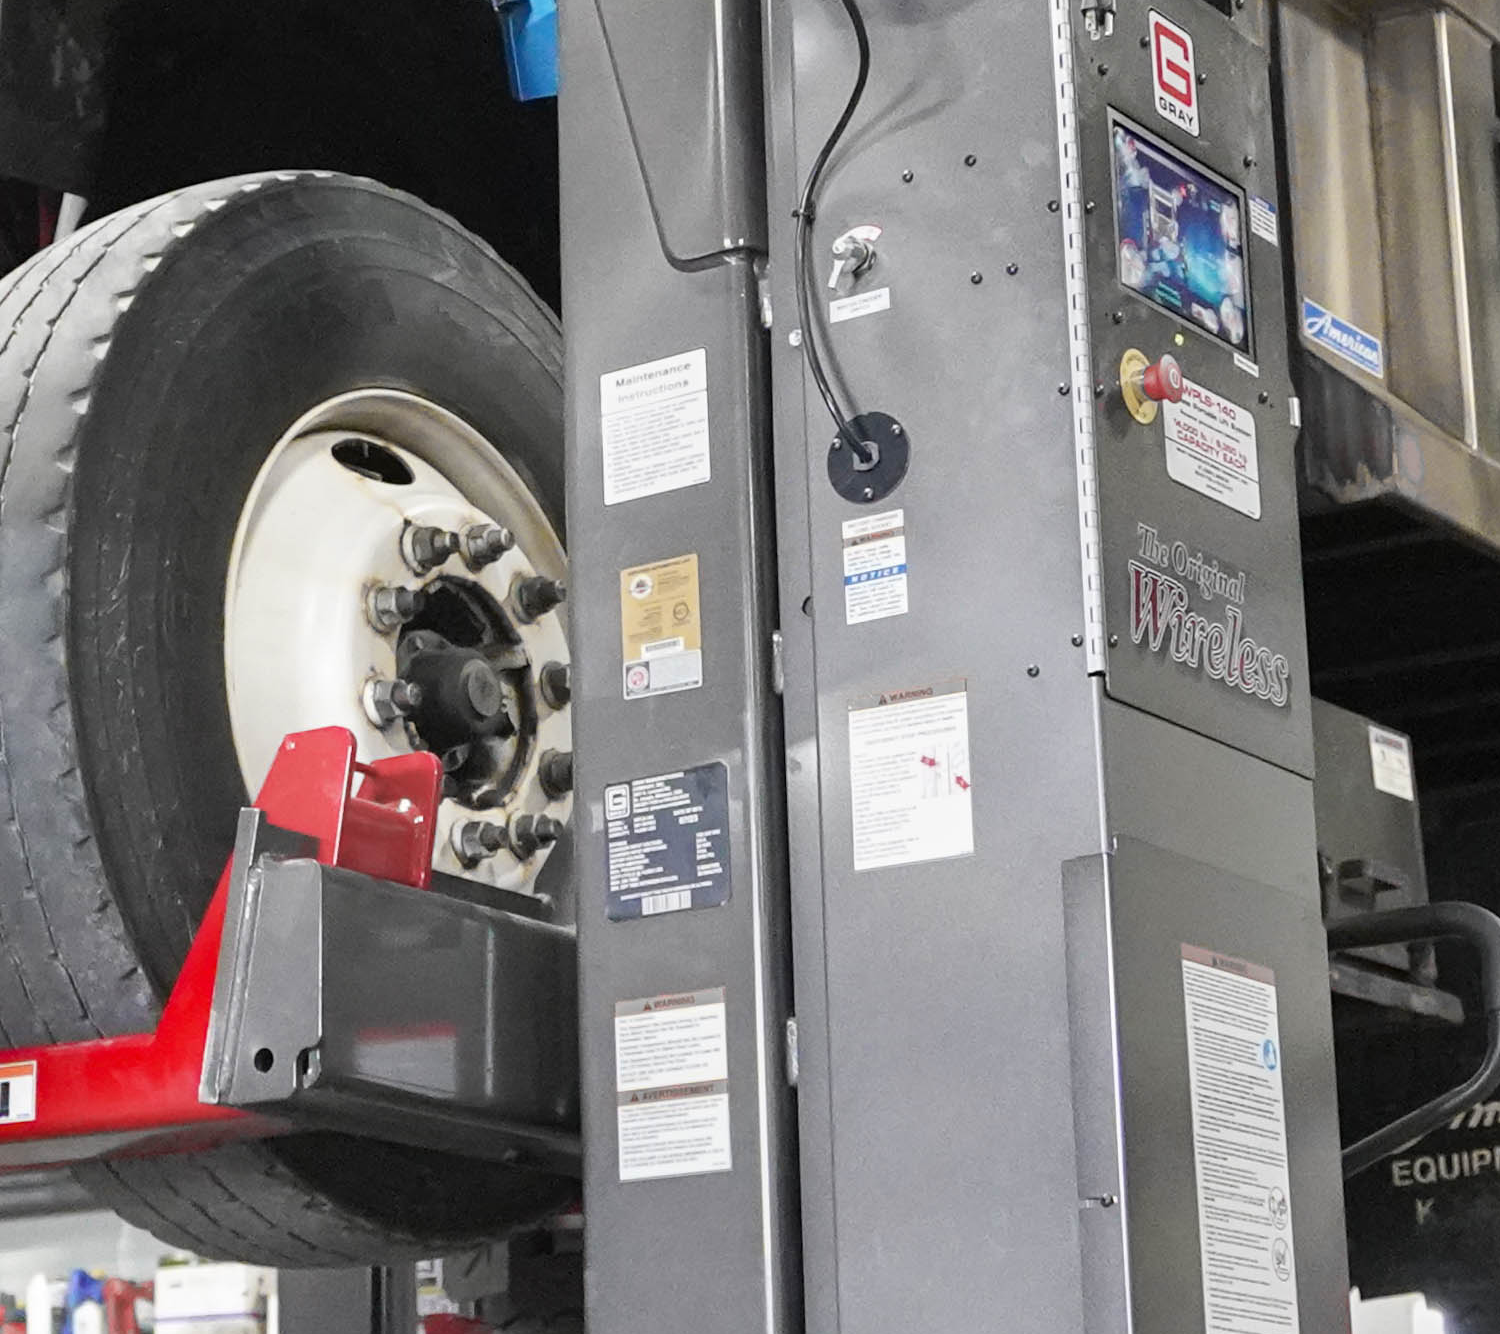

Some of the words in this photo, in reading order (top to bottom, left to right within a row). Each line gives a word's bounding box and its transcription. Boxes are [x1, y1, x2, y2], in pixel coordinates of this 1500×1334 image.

[1158, 96, 1194, 128] GRAY
[615, 362, 692, 388] Maintenance
[617, 378, 690, 404] Instructions
[851, 567, 899, 583] NOTICE
[1137, 523, 1168, 567] The
[1171, 541, 1245, 604] Original
[1128, 559, 1289, 707] Wireless
